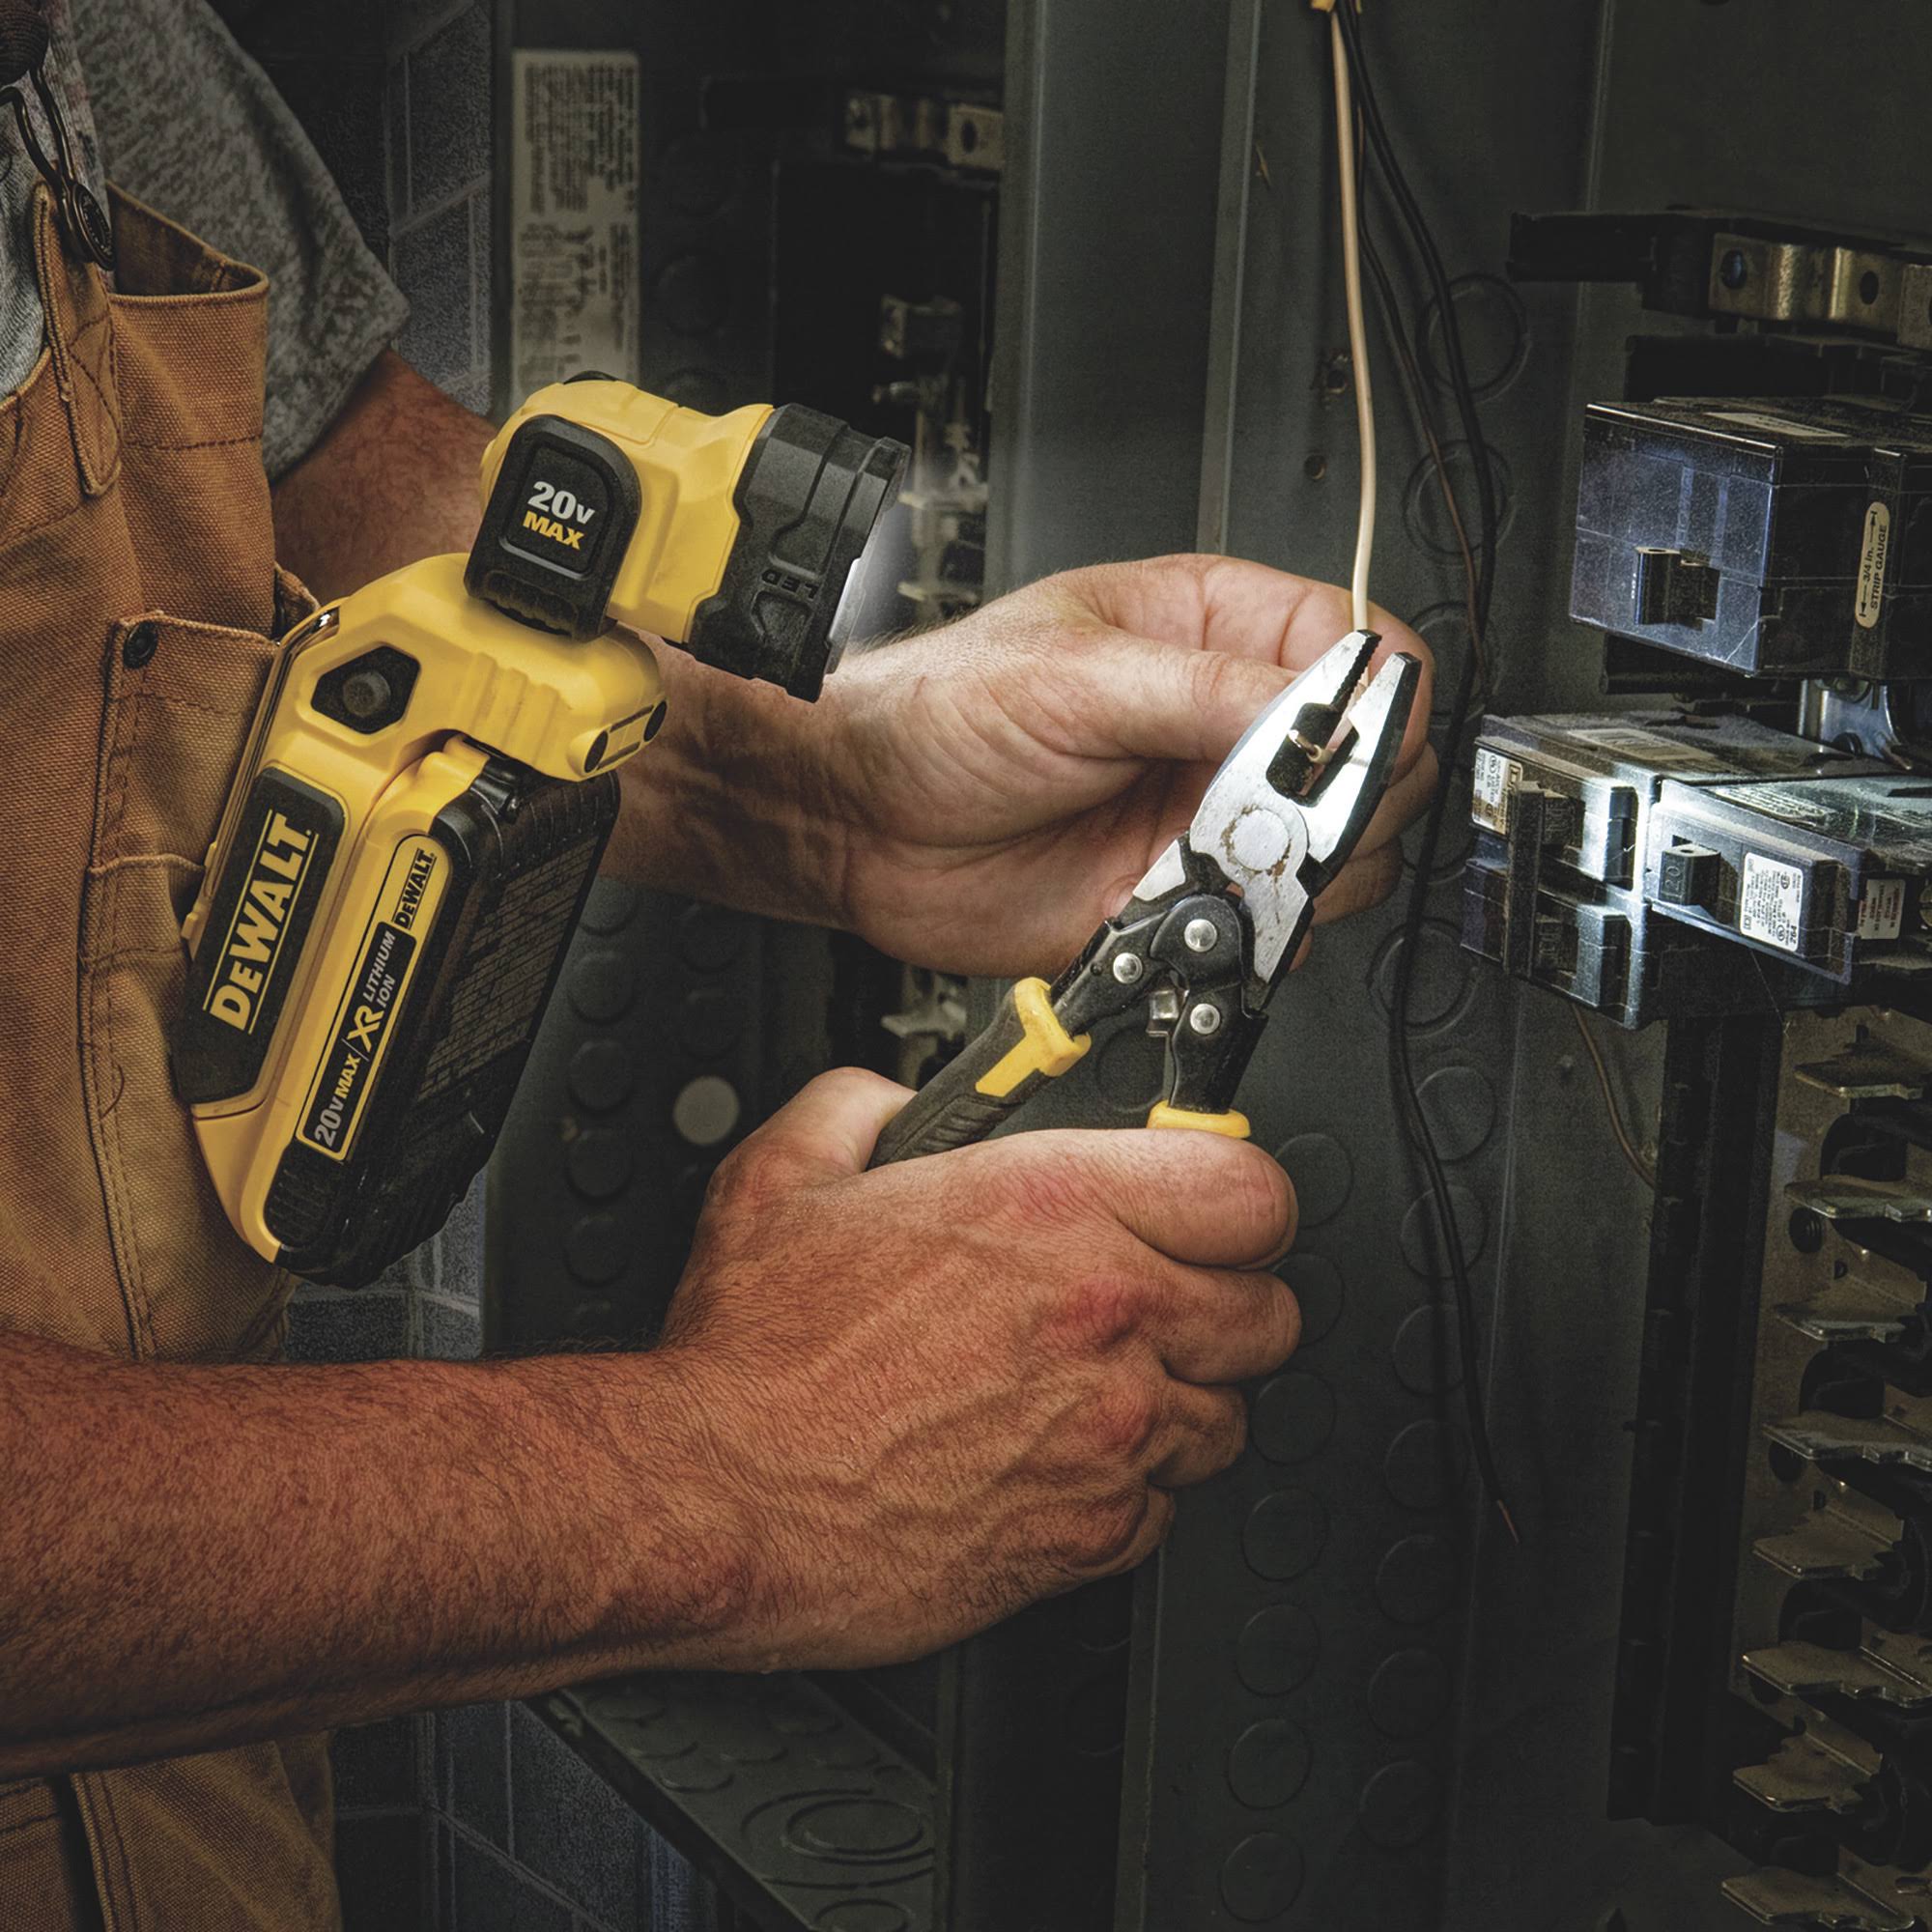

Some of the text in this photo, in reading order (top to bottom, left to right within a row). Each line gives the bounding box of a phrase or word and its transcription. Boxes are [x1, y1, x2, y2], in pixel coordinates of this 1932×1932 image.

[523, 510, 584, 550] MAX
[1863, 564, 1872, 582] 3/4
[1870, 525, 1888, 610] STRIP GAUGE
[362, 930, 396, 1003] LITHIUM
[376, 975, 396, 1009] ION
[347, 1005, 384, 1053] XR
[334, 1053, 361, 1099] MAX
